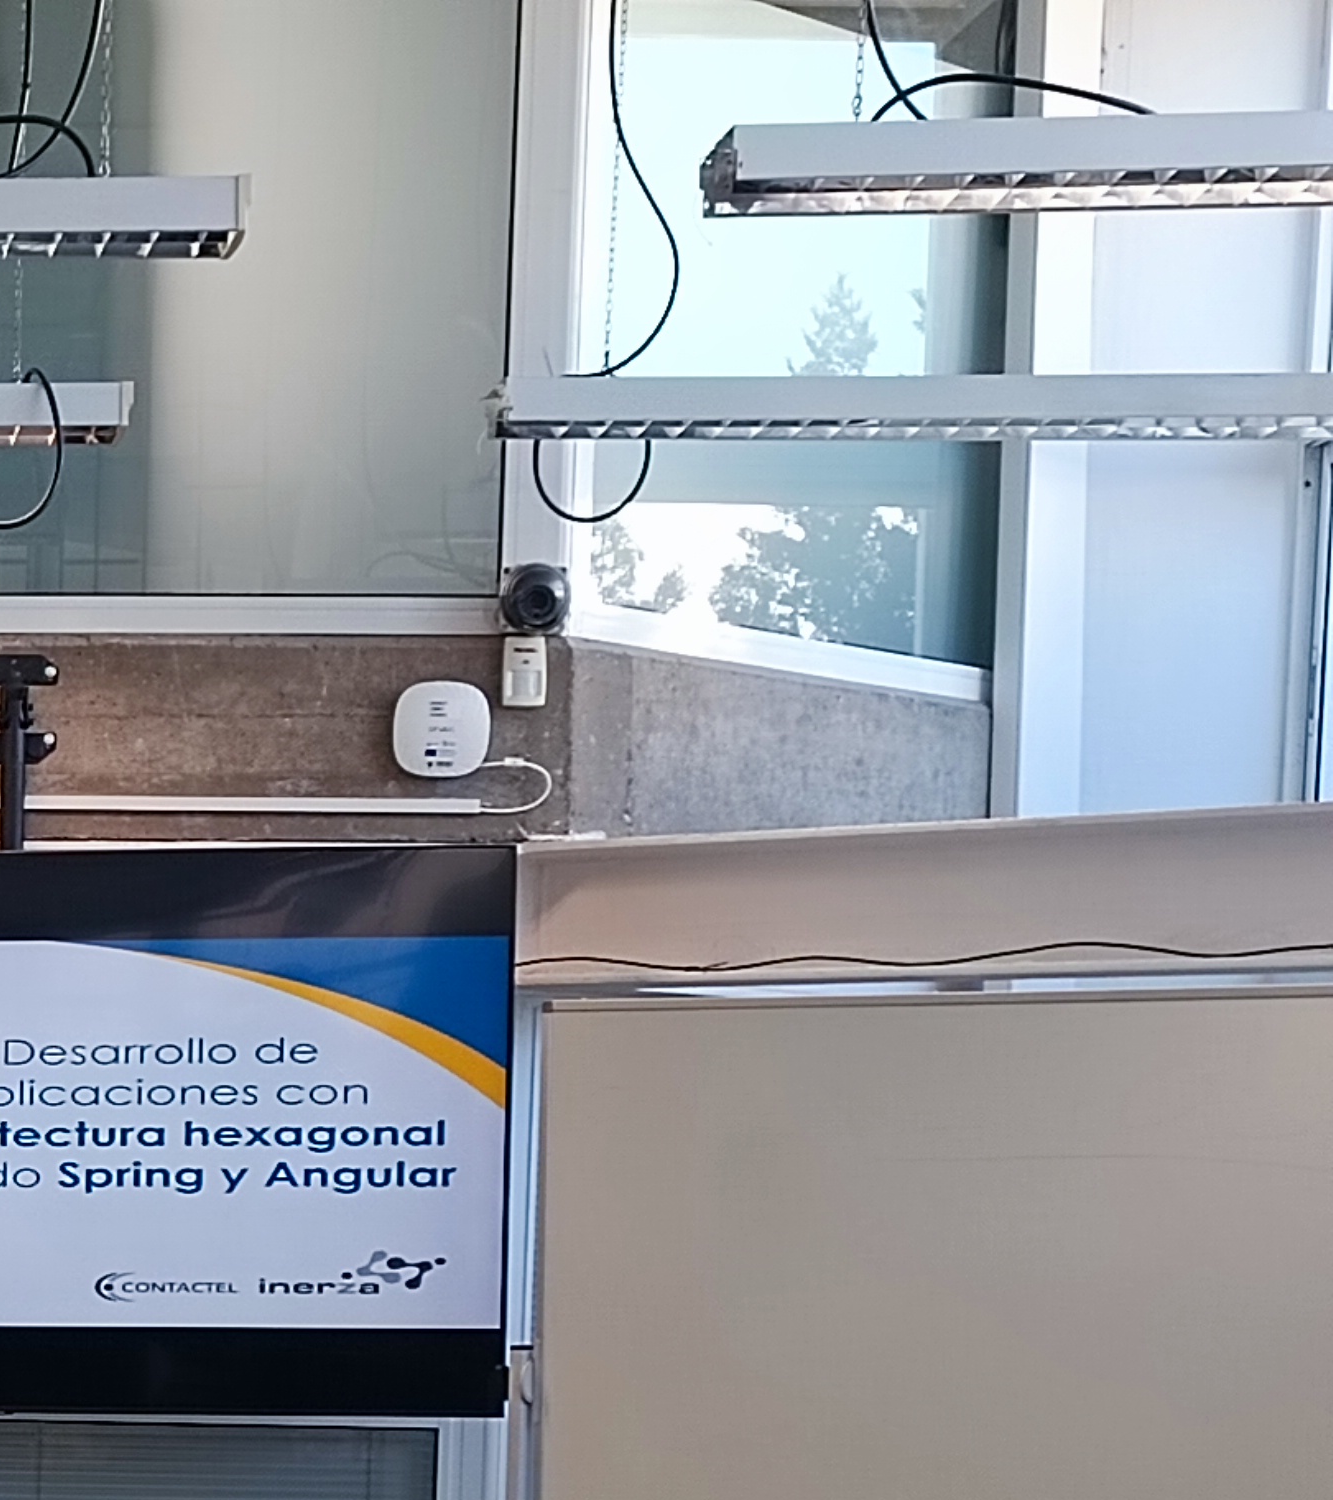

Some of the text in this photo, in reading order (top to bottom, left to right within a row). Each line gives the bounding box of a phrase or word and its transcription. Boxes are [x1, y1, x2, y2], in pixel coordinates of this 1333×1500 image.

[3, 1037, 320, 1067] Desarrollo de
[275, 1084, 369, 1106] con
[183, 1119, 447, 1152] hexagonal
[57, 1161, 204, 1193] Spring
[220, 1168, 249, 1194] y
[264, 1160, 458, 1191] Angular
[121, 1278, 380, 1295] CONTACTEL inerza
